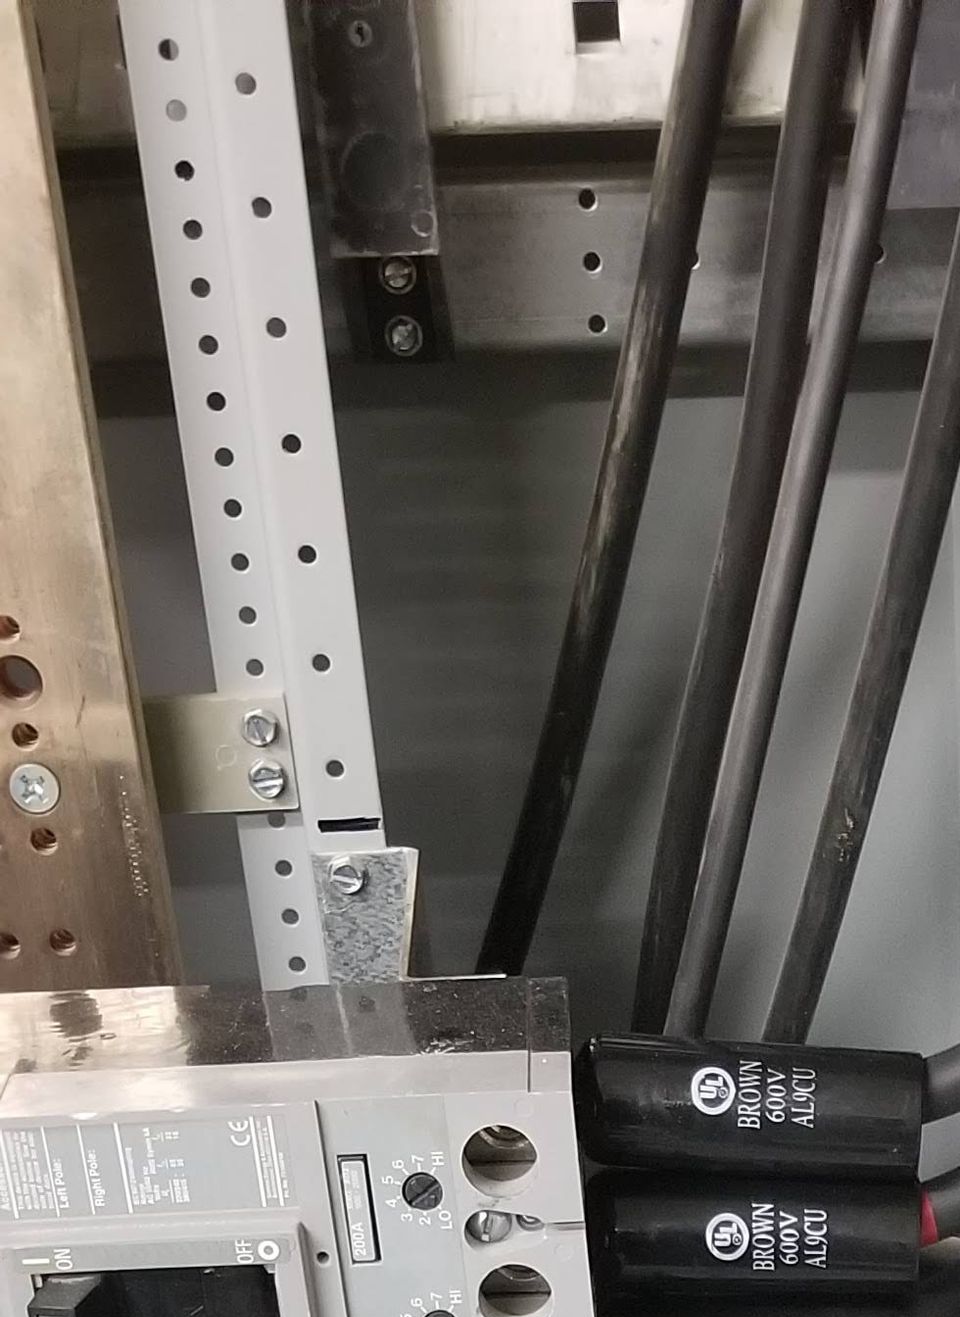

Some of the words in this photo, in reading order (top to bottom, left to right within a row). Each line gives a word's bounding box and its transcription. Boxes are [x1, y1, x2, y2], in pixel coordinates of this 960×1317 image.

[737, 1060, 763, 1129] BROWN
[765, 1068, 787, 1123] 600V
[791, 1067, 816, 1129] AL9CU
[88, 1149, 100, 1177] Pole:
[392, 1159, 404, 1169] 6
[411, 1154, 424, 1163] 7
[430, 1151, 445, 1166] HI
[53, 1158, 65, 1186] Pole:
[381, 1175, 394, 1185] 5
[57, 1186, 69, 1209] Left
[92, 1177, 106, 1207] Right
[384, 1199, 397, 1208] 4
[401, 1213, 413, 1222] 3
[419, 1217, 431, 1225] 2
[439, 1210, 453, 1230] LO
[351, 1221, 367, 1257] 200A
[751, 1203, 775, 1271] BROWN
[779, 1210, 800, 1265] 600V
[803, 1208, 828, 1269] AL9CU
[54, 1248, 73, 1271] ON
[234, 1239, 254, 1264] OFF
[411, 1298, 423, 1307] 6
[430, 1292, 443, 1301] 7
[448, 1290, 463, 1304] HI
